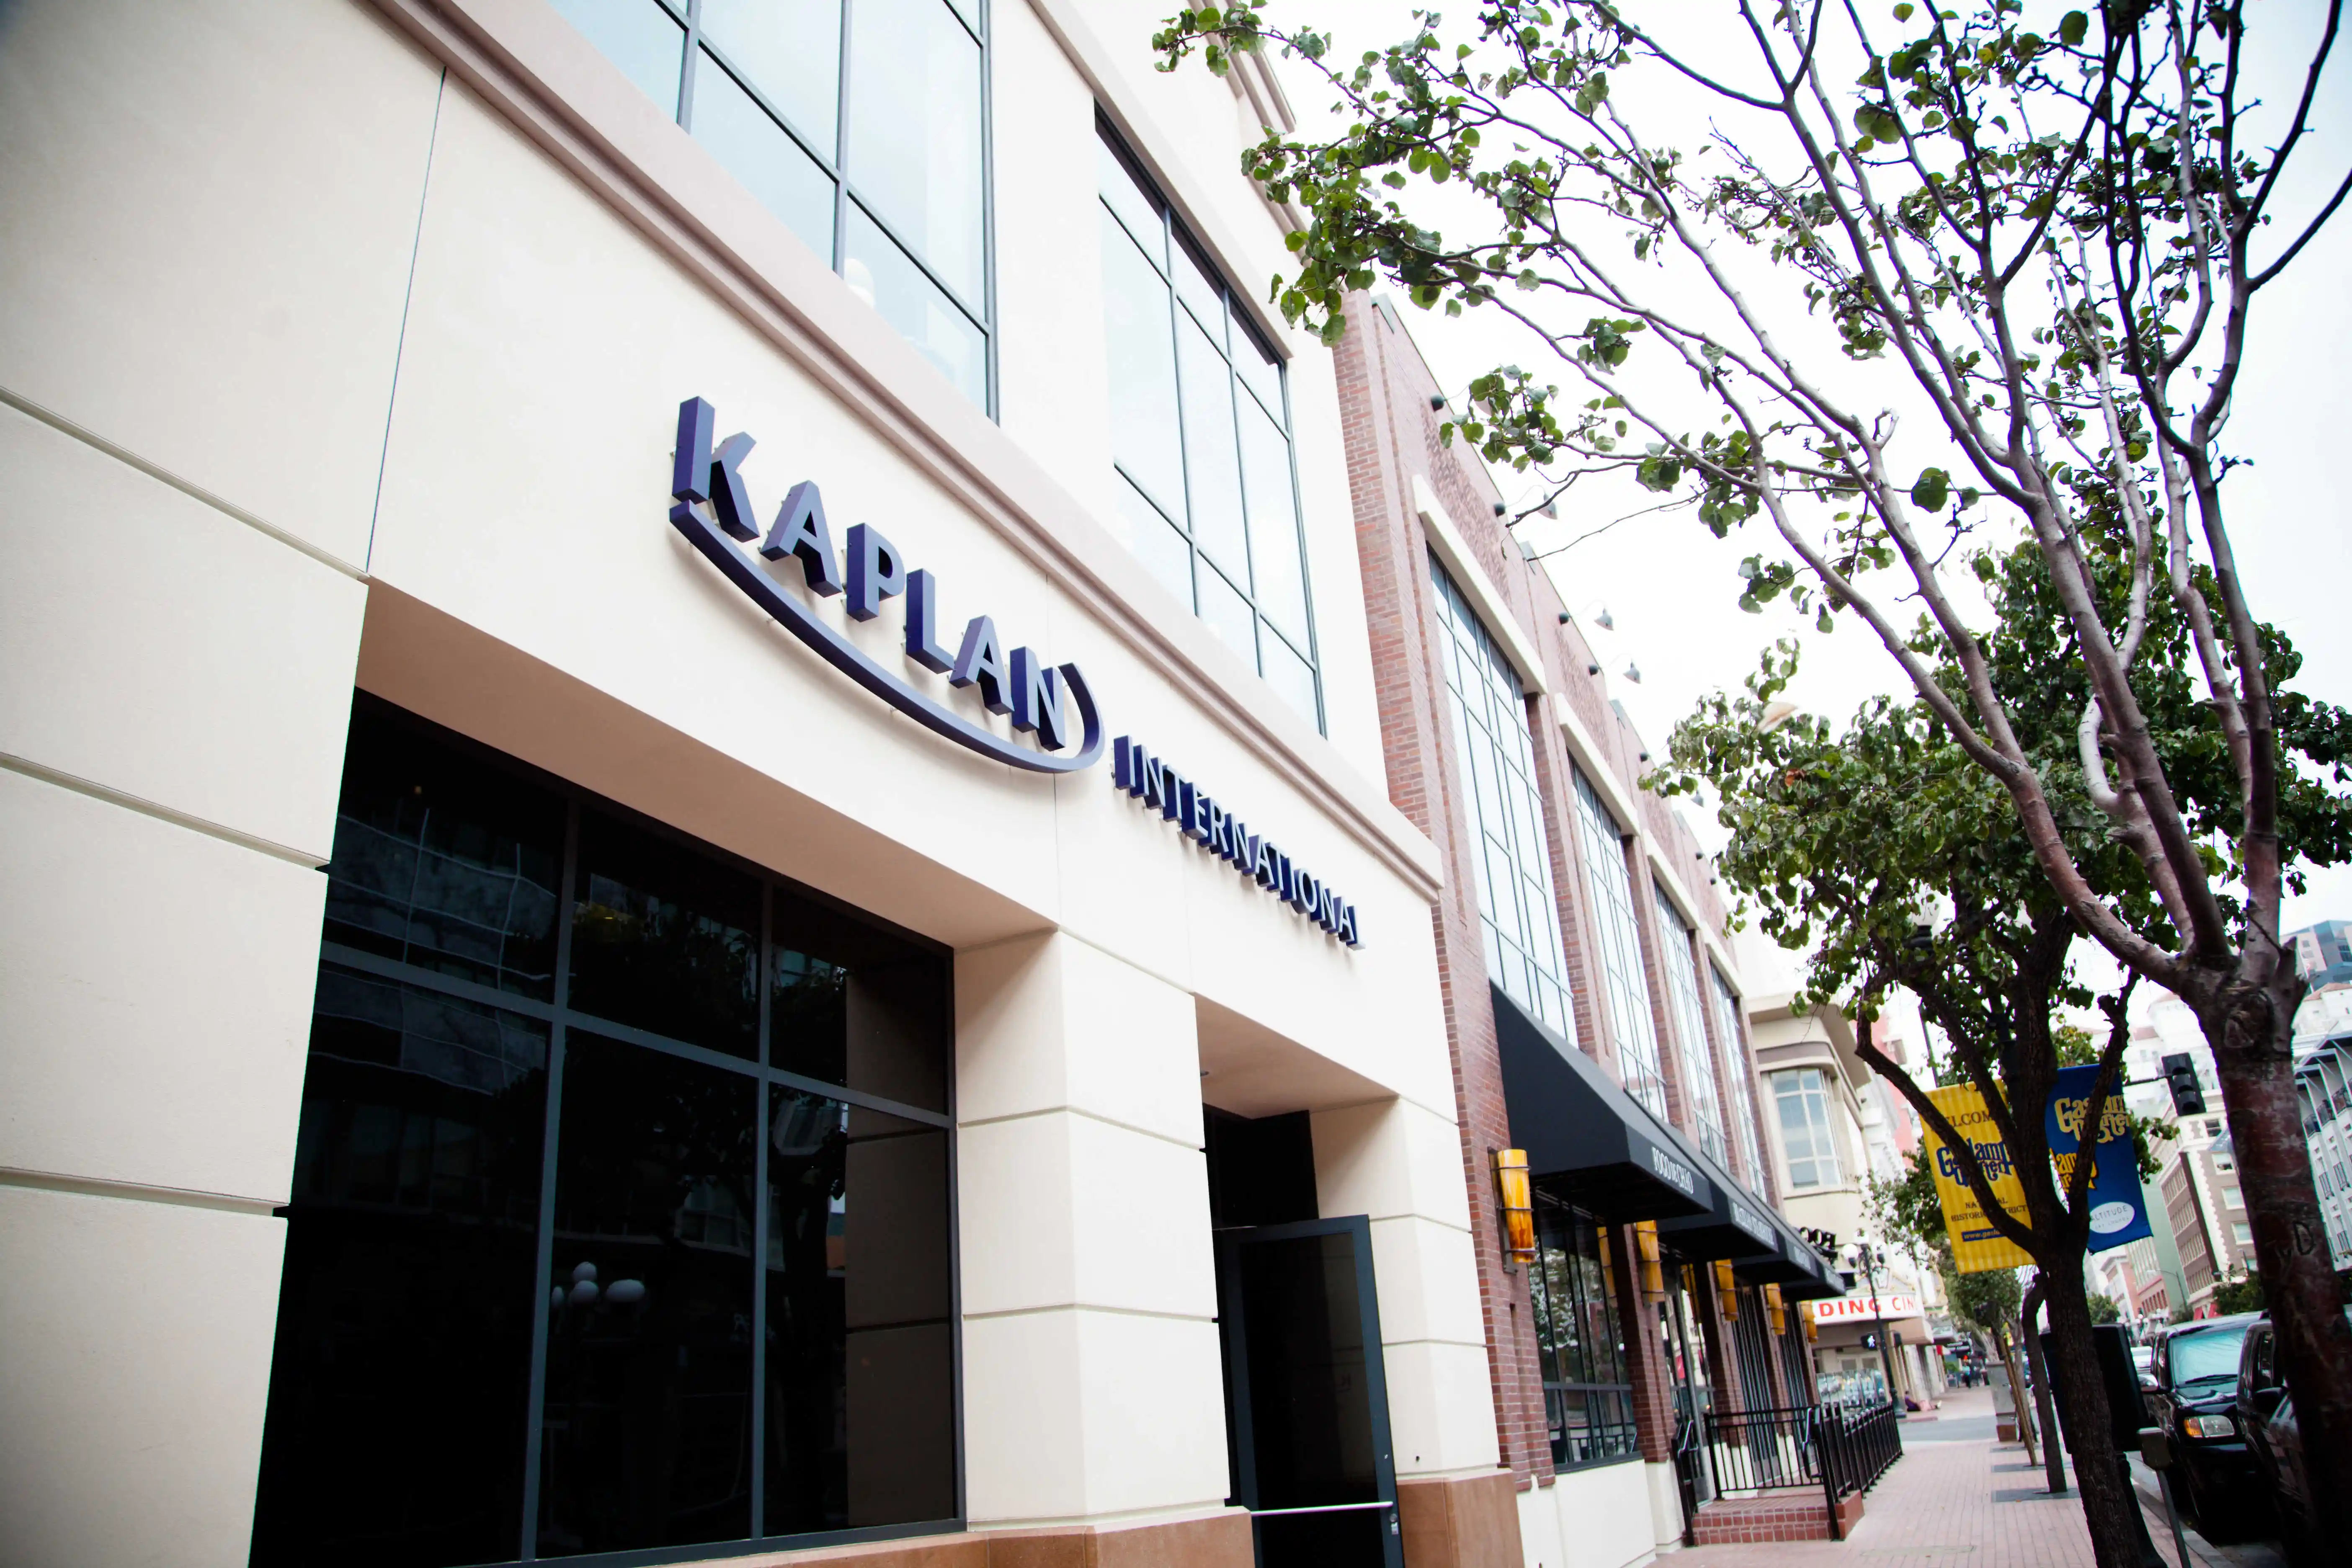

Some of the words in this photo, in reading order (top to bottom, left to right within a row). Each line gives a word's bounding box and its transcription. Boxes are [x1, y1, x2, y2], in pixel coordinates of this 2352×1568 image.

[672, 395, 1067, 752] KAPLAN
[1113, 735, 1366, 951] INTERNATIONAL
[1947, 1110, 1991, 1127] LCOM
